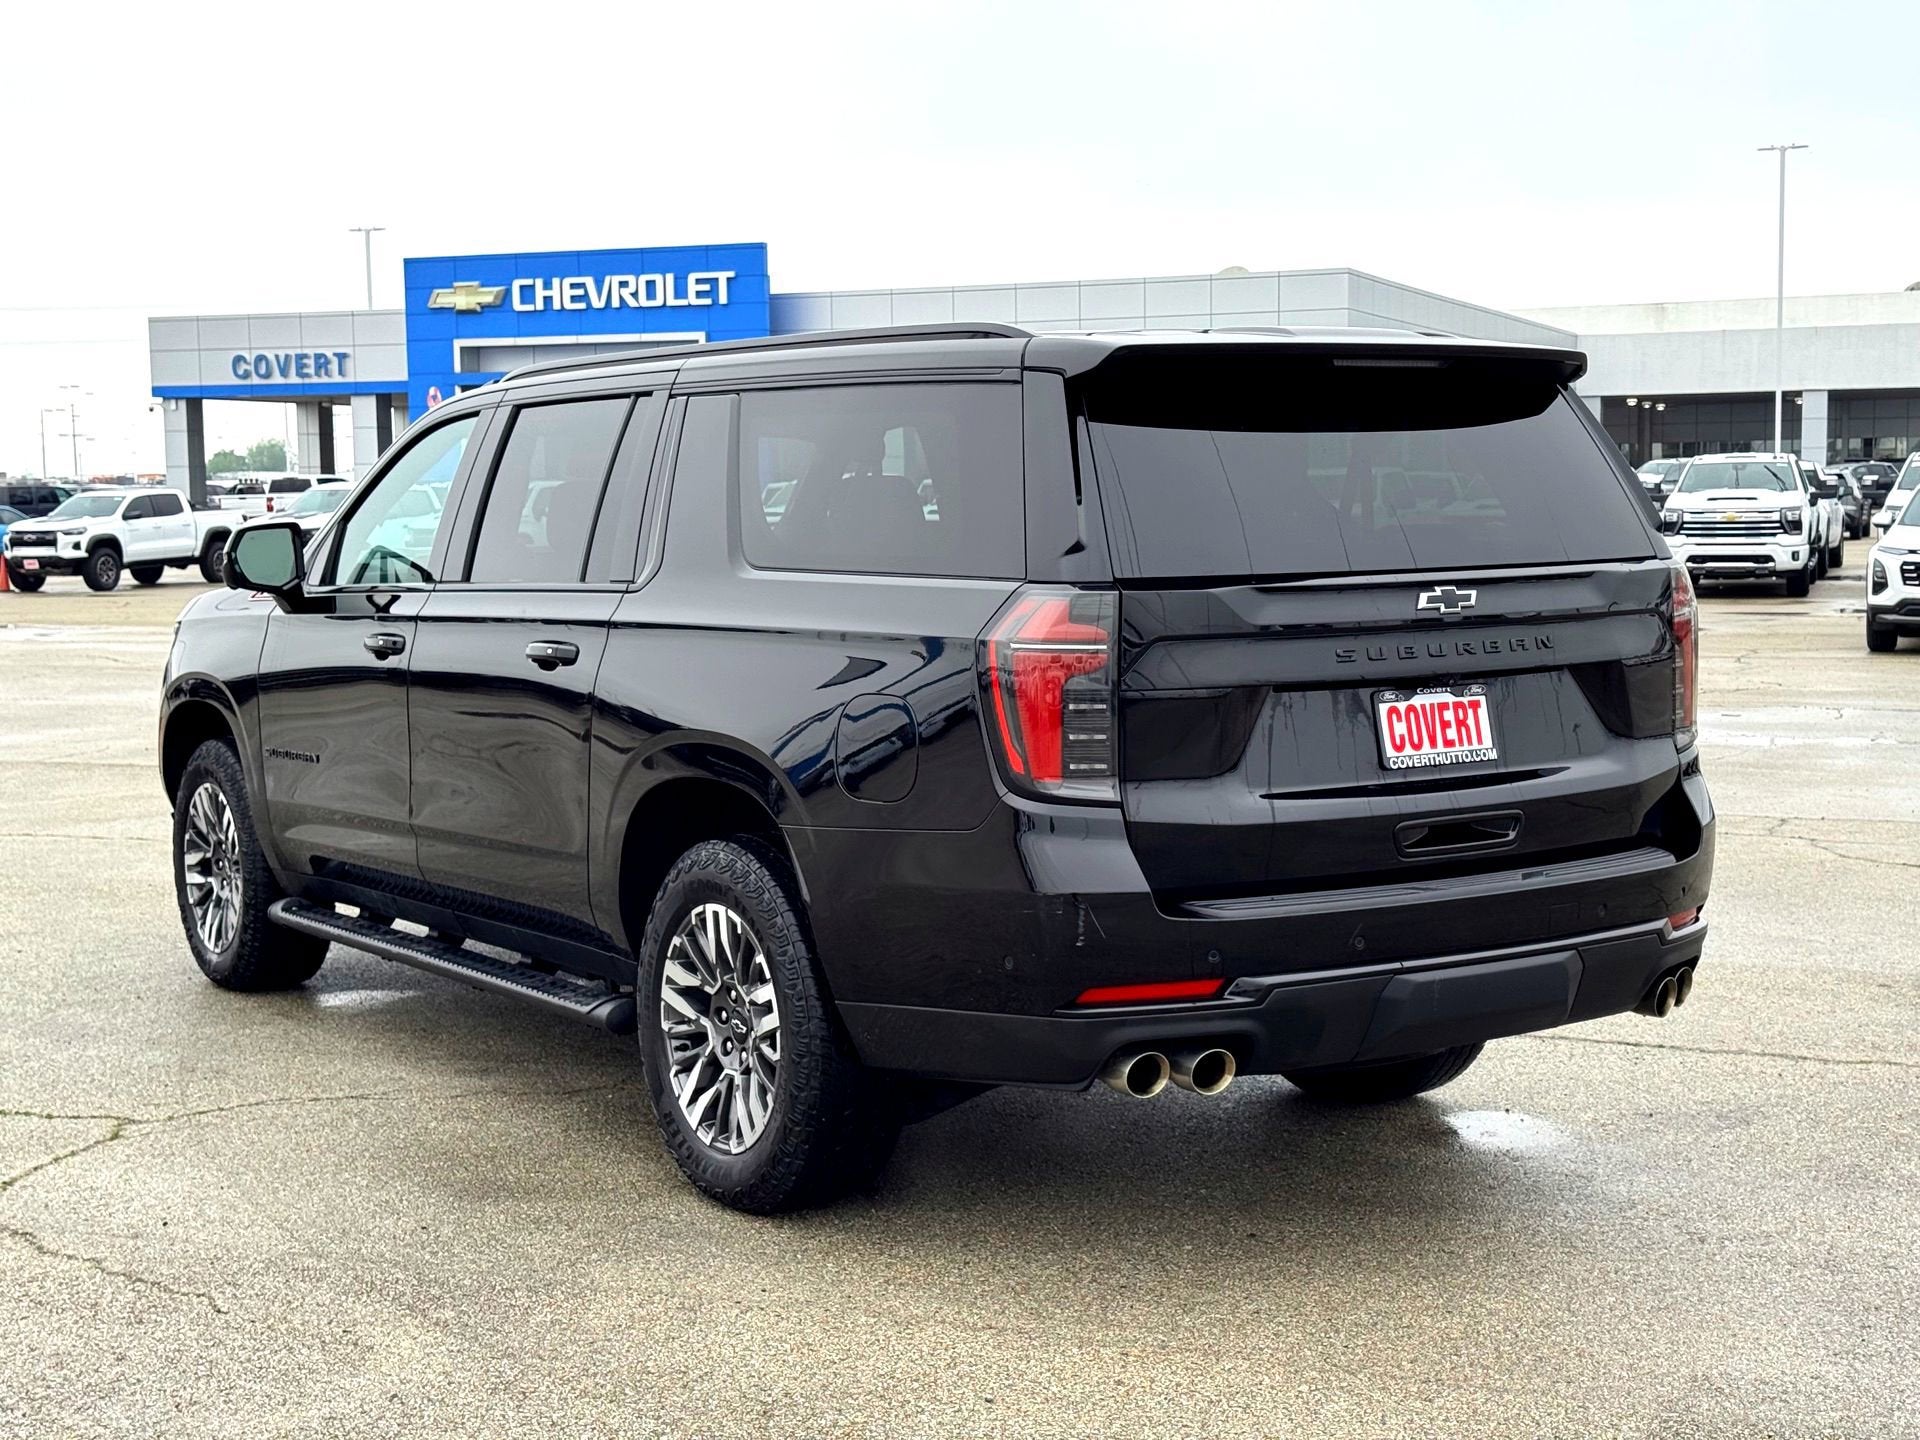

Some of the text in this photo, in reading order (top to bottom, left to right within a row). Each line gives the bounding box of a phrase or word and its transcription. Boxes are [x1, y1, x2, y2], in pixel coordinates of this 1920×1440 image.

[511, 270, 736, 312] CHEVROLET
[231, 352, 351, 380] COVERT
[1335, 635, 1554, 663] SUBURBAN
[1386, 699, 1483, 753] COVERT
[1389, 748, 1498, 770] COVERTHUTTO.COM
